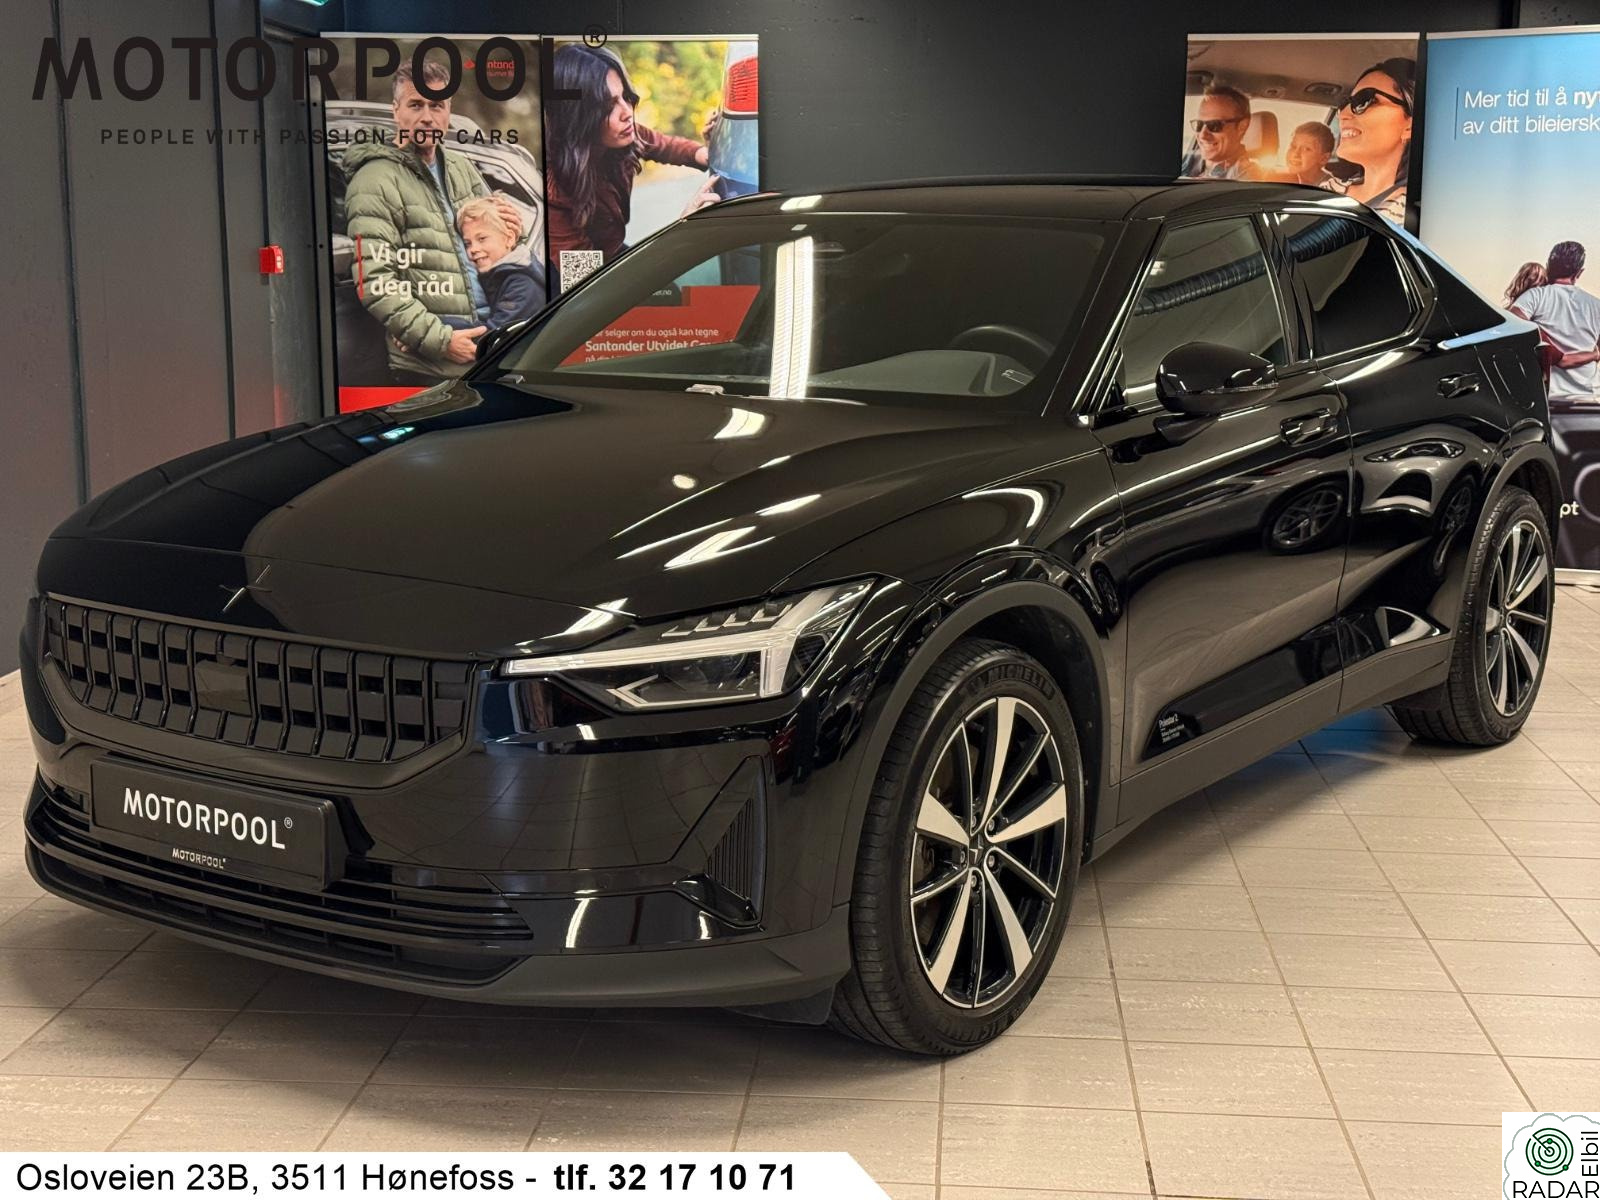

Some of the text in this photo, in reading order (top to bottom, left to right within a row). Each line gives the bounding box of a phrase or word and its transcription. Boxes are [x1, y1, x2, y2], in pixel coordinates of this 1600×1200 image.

[1464, 90, 1501, 108] Mer
[1507, 89, 1530, 107] tid
[1535, 88, 1549, 106] til
[1555, 86, 1568, 106] å
[1463, 114, 1600, 134] av ditt bileiersk
[368, 242, 427, 269] Vi gir
[370, 274, 454, 300] deg råd
[605, 328, 629, 338] selger
[645, 328, 657, 336] du
[658, 328, 677, 338] også
[678, 328, 693, 336] kan
[695, 328, 719, 338] tegne
[585, 340, 645, 352] Santander
[646, 340, 689, 351] Utvidet
